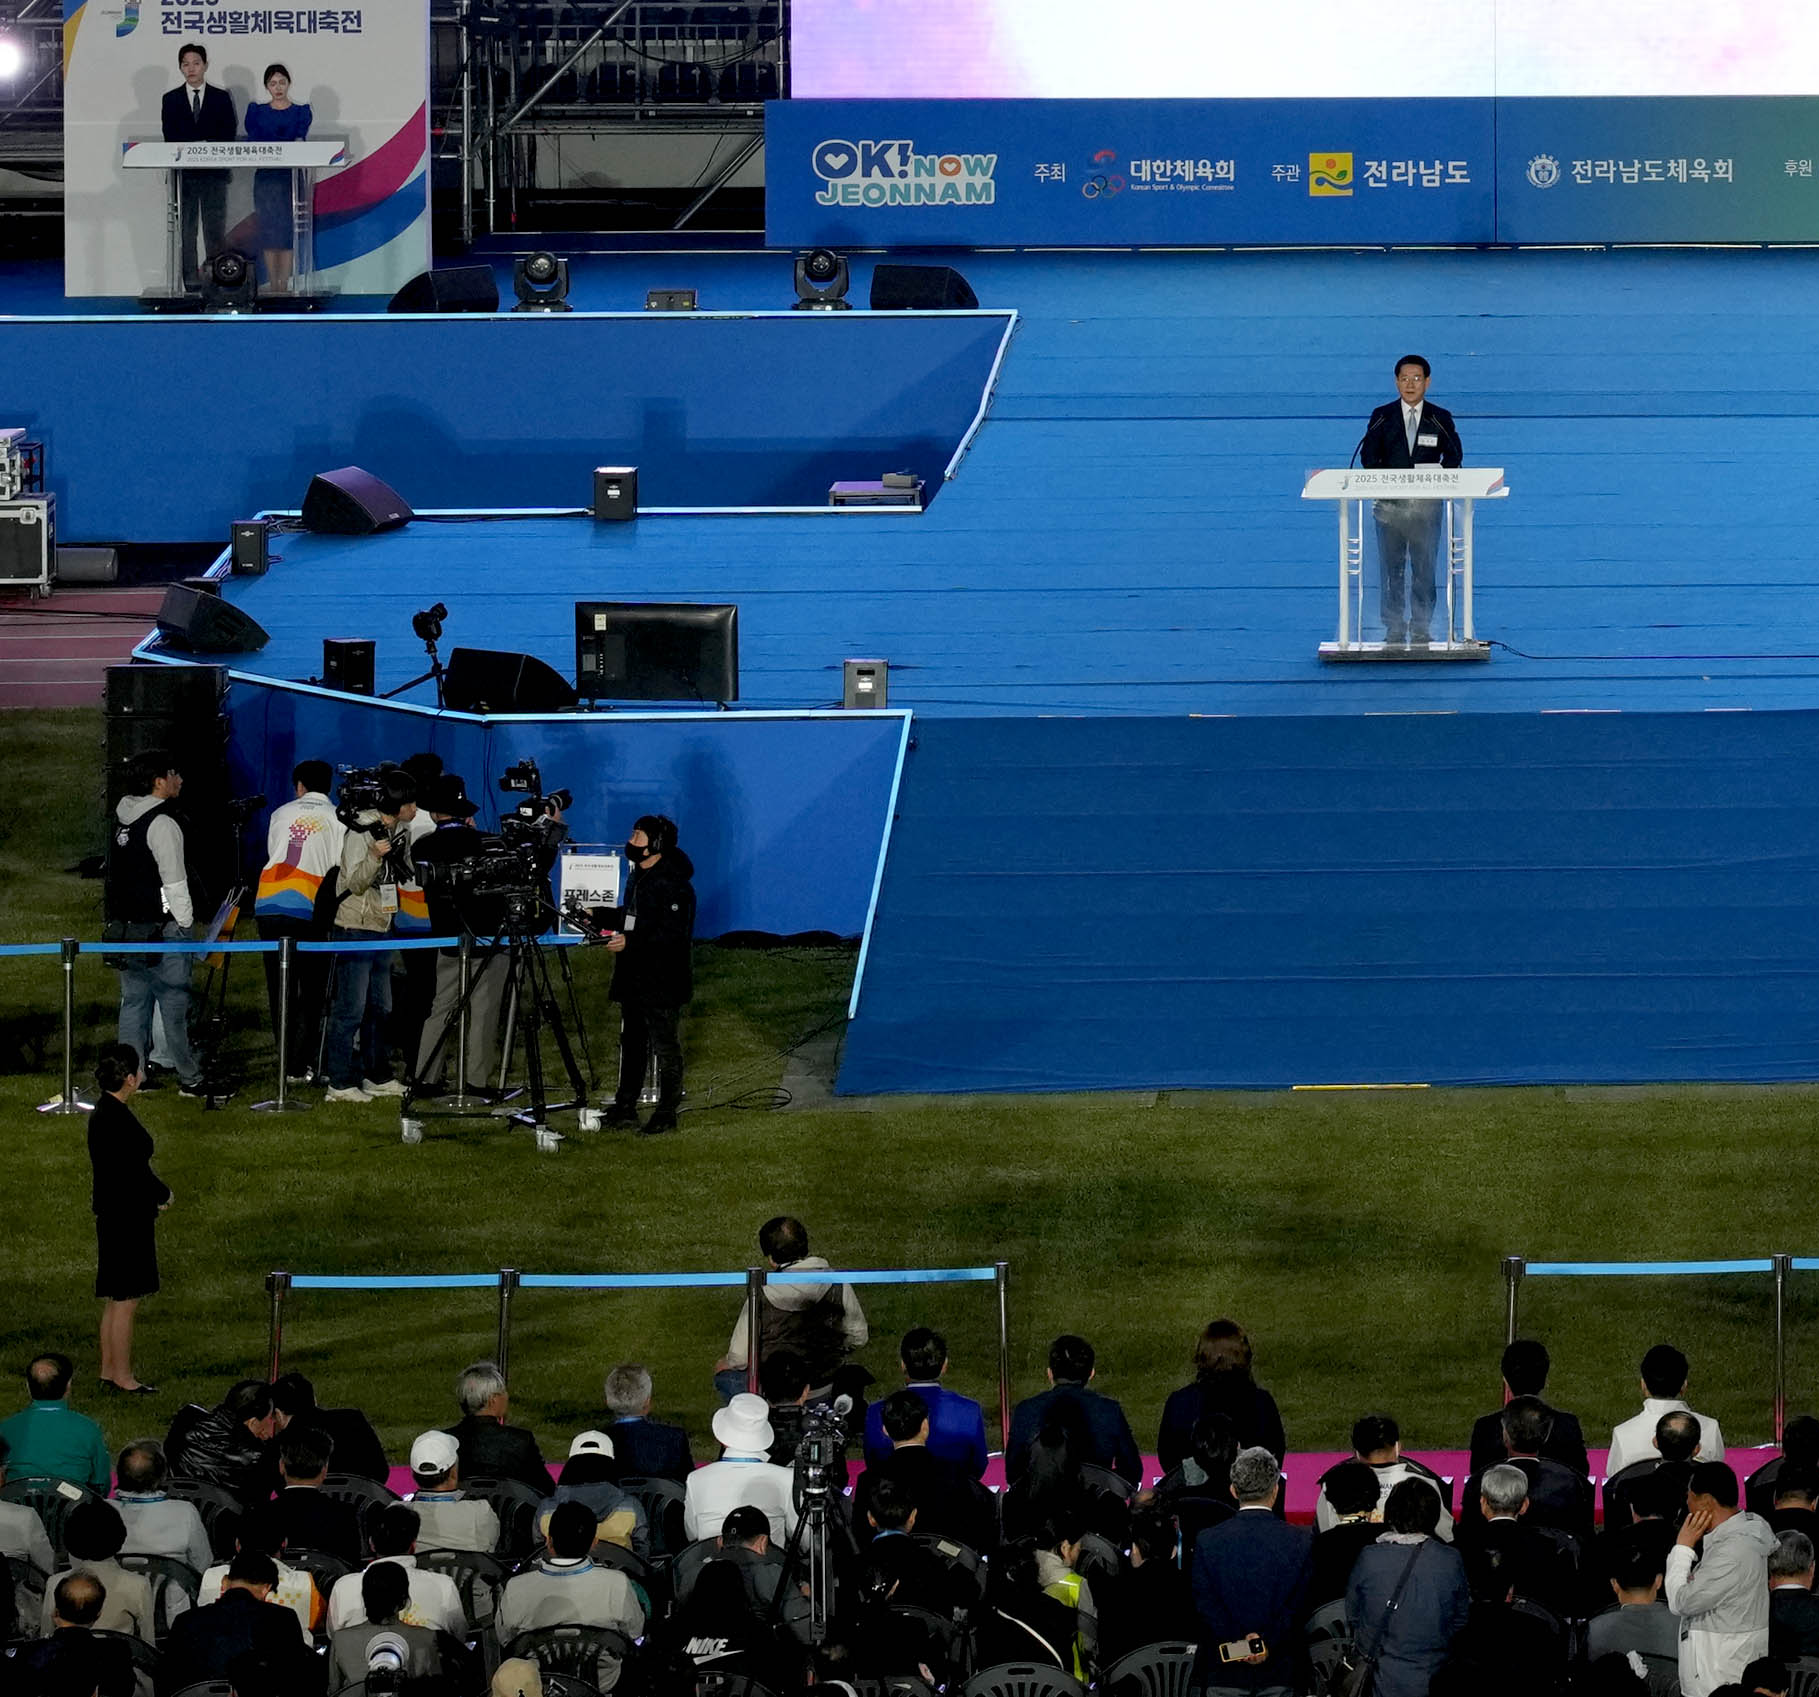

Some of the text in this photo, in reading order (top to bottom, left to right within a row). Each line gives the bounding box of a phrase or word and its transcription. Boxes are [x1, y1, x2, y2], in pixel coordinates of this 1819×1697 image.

[160, 9, 363, 35] 전국생활체육대축전
[814, 142, 994, 180] OK! NOW
[1034, 159, 1235, 183] 주최 대한체육회
[1571, 158, 1734, 184] 전라남도체육회
[1784, 159, 1813, 178] 후원
[1271, 160, 1471, 188] 주관 전라남도
[817, 181, 993, 204] JEONNAM
[685, 1636, 729, 1655] NIKE
